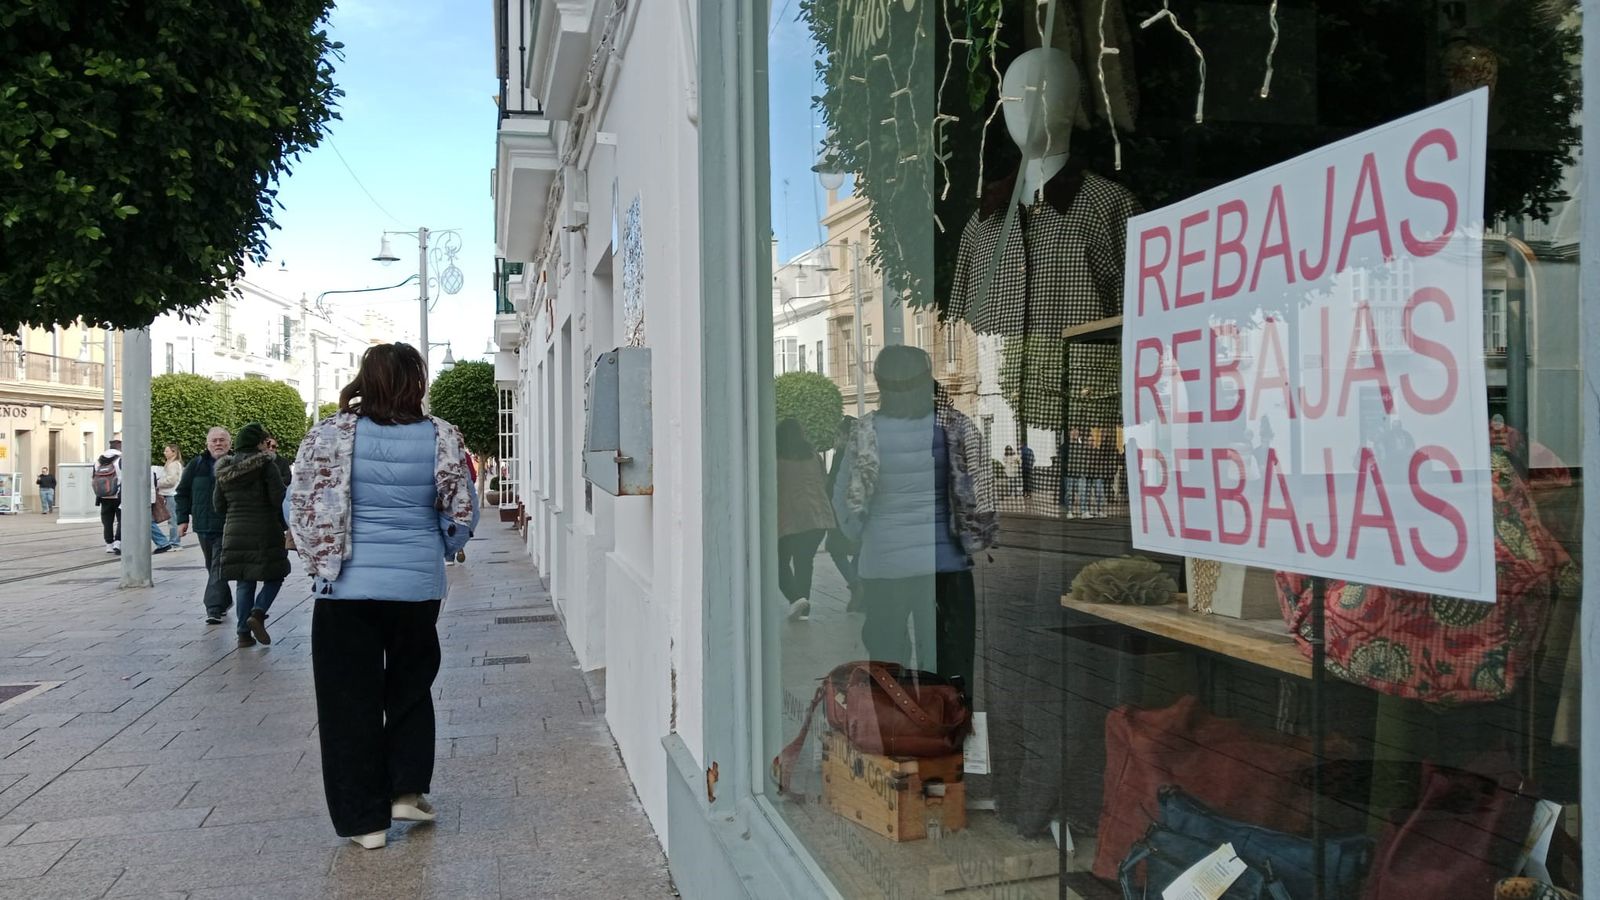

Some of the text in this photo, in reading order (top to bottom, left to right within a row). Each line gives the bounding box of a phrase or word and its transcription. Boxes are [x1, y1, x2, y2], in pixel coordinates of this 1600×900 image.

[1137, 127, 1459, 317] REBAJAS
[1133, 286, 1459, 425] REBAJAS
[1137, 444, 1468, 573] REBAJAS
